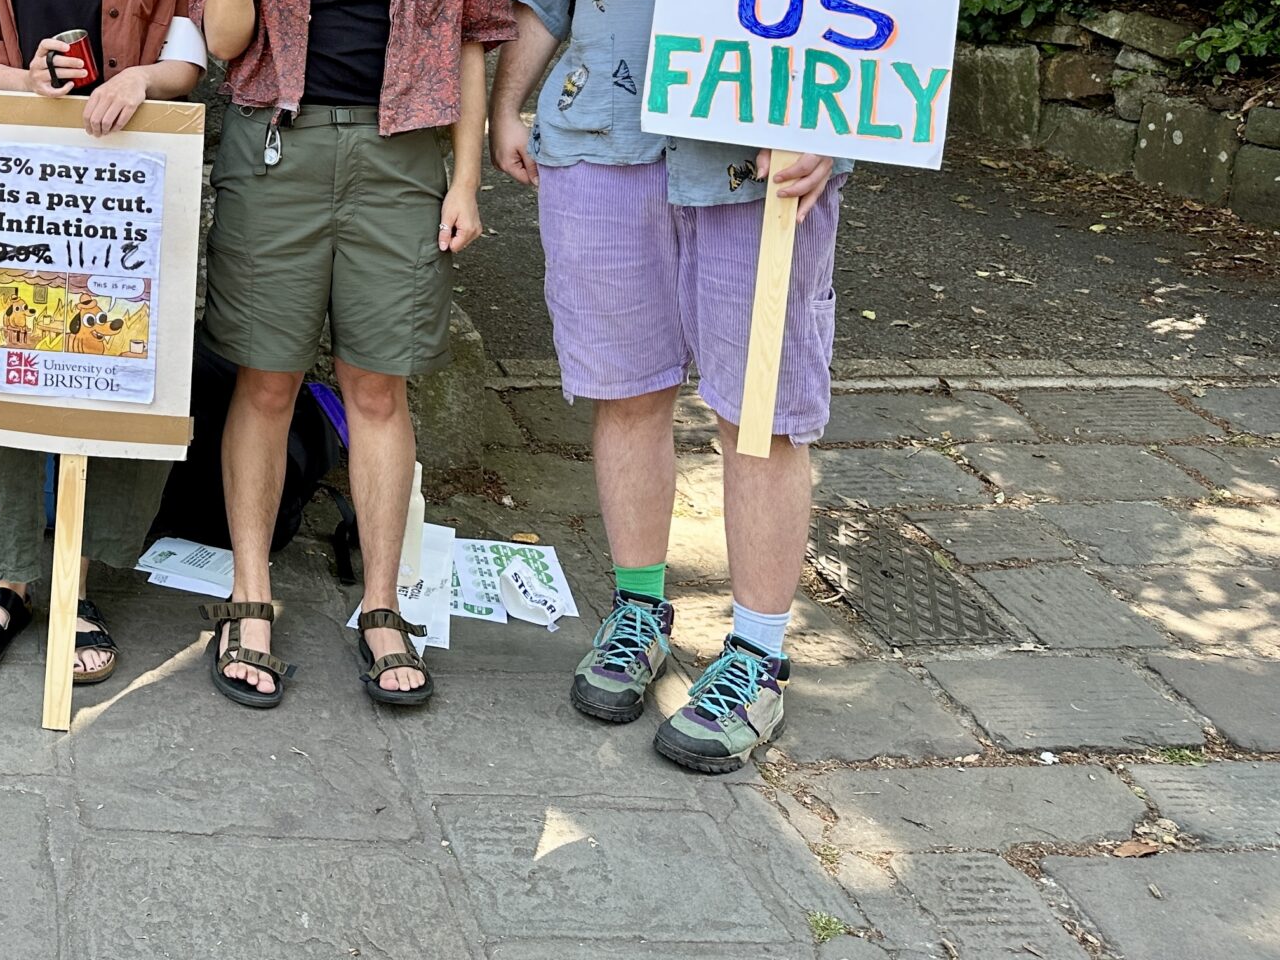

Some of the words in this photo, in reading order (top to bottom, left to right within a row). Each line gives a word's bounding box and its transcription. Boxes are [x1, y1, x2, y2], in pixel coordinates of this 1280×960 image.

[647, 34, 951, 143] FAIRLY
[39, 162, 91, 184] pay
[94, 162, 146, 184] rise
[25, 191, 41, 205] a
[47, 193, 97, 214] pay
[102, 195, 153, 214] cut.
[123, 221, 148, 241] is
[43, 359, 103, 376] University
[104, 364, 119, 375] of
[43, 373, 120, 391] BRISTOL
